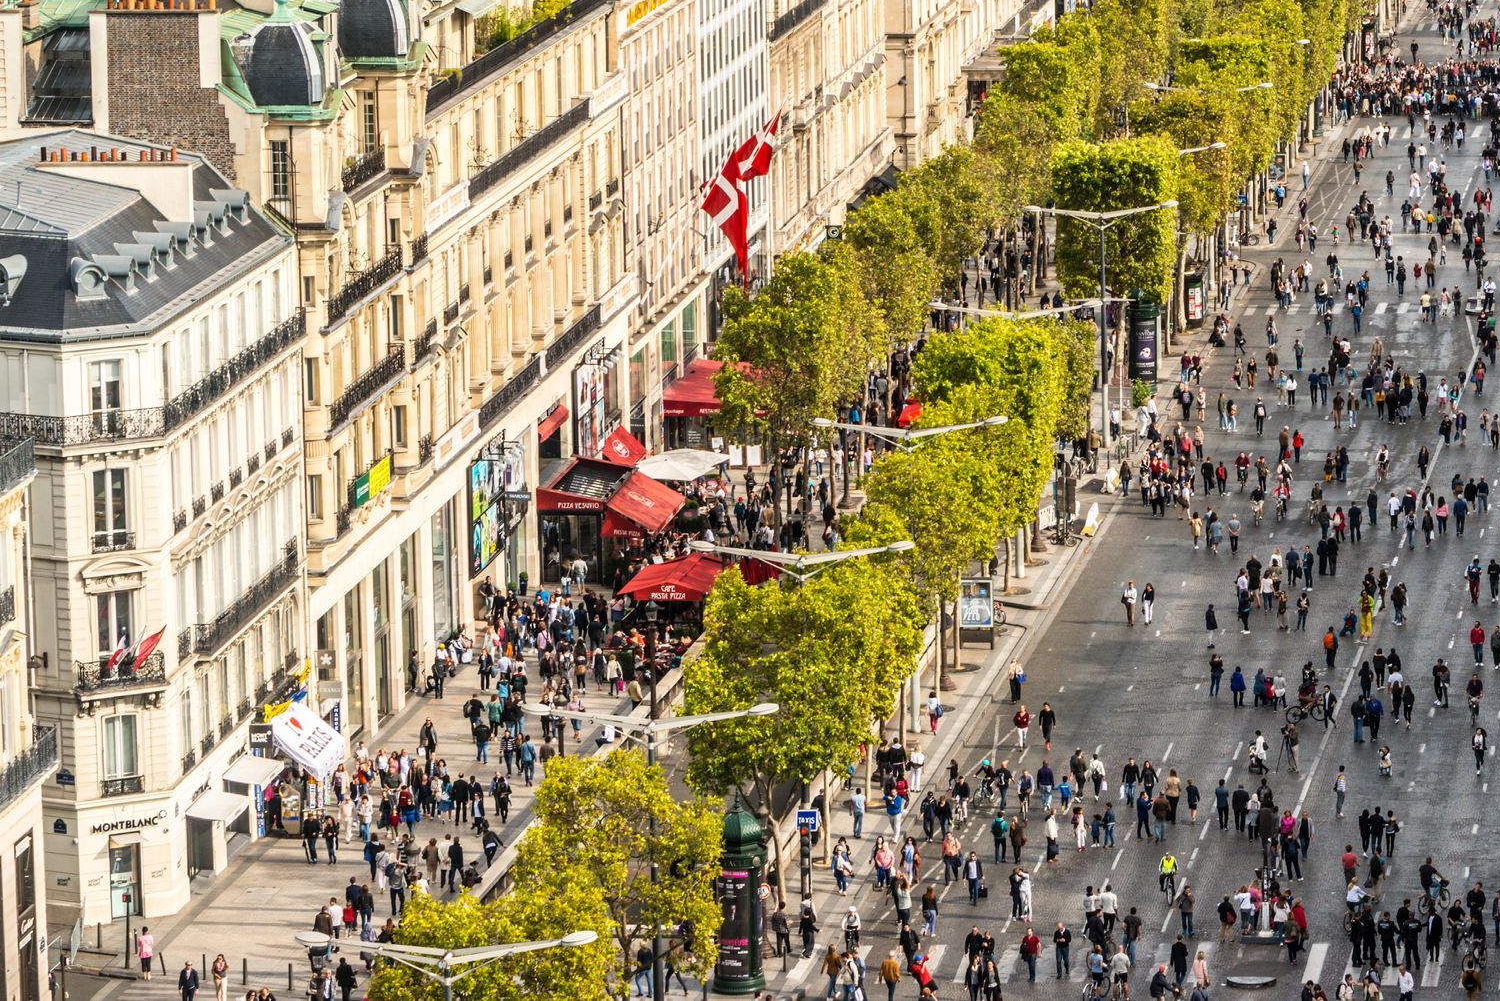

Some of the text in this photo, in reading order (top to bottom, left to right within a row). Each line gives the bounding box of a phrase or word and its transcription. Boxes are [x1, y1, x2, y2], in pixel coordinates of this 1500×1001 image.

[651, 592, 686, 600] PASTA PIZZA
[299, 726, 333, 759] PARIS
[92, 816, 159, 834] MONTBLANC
[798, 816, 816, 824] TAXIS
